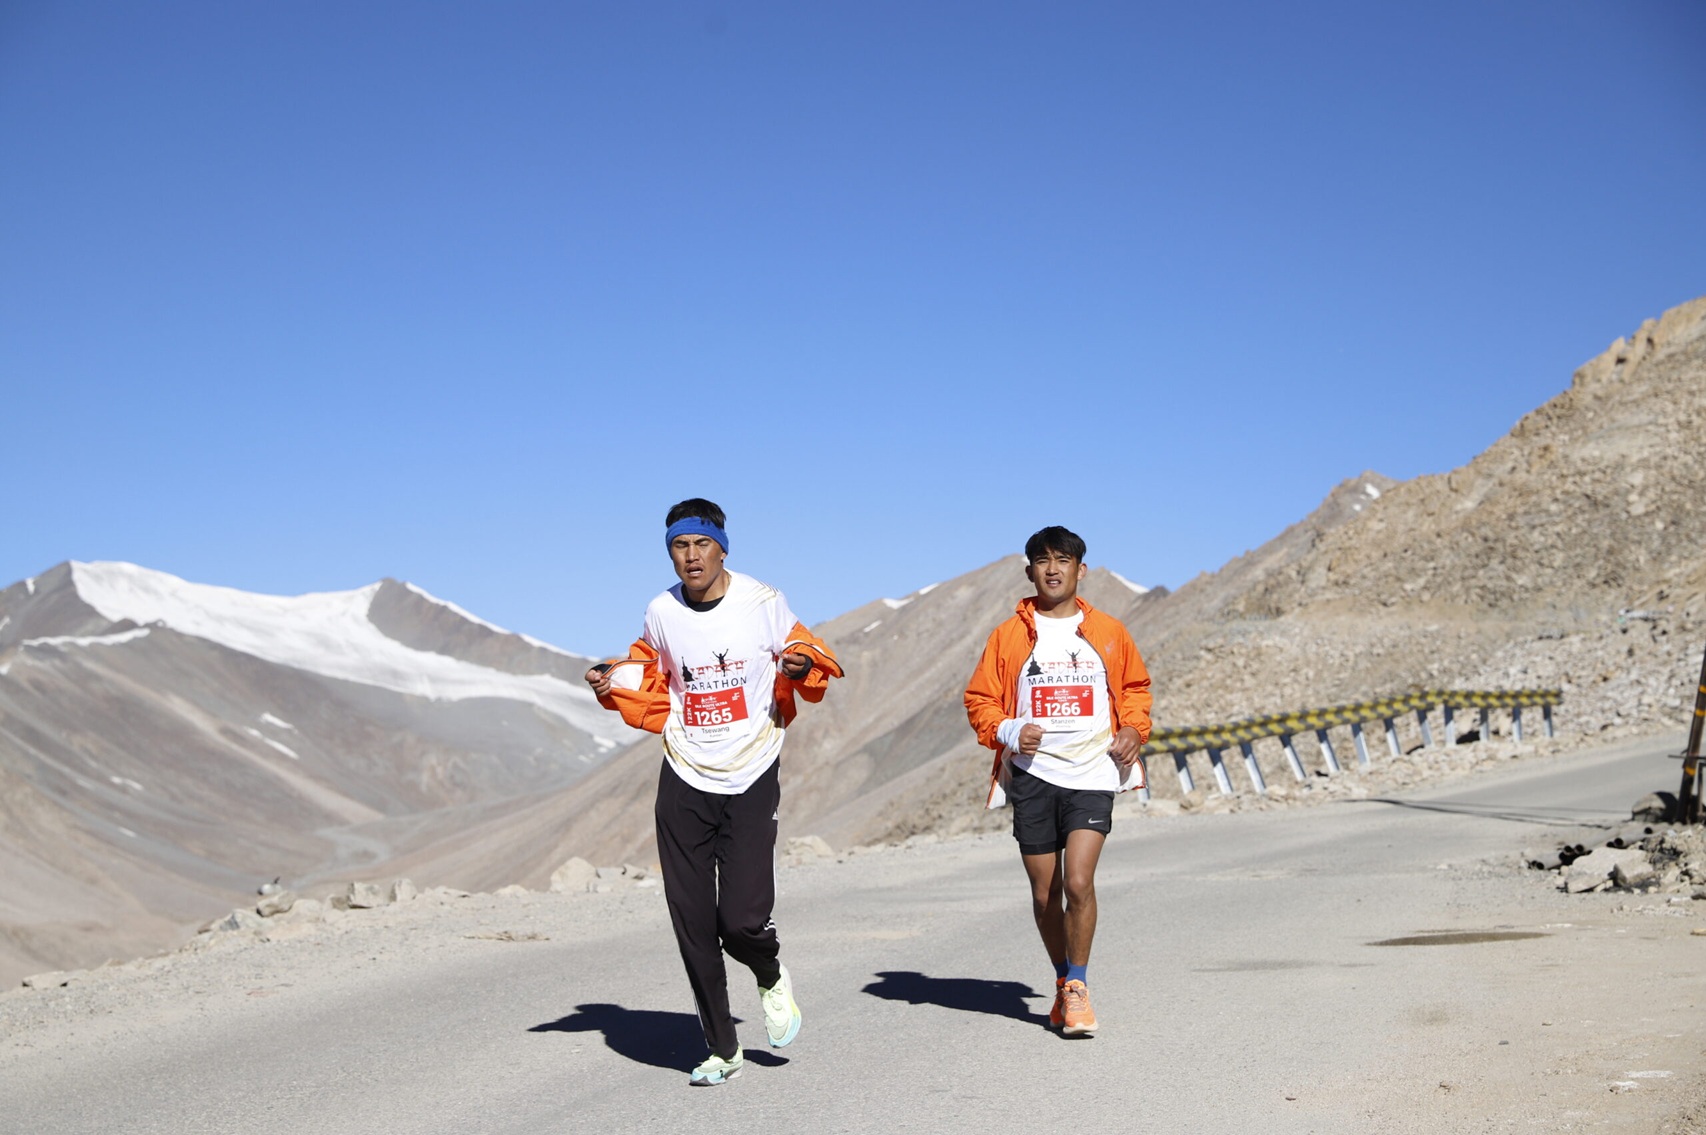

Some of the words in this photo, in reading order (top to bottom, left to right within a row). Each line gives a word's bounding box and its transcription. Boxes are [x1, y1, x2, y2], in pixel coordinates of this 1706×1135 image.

[1028, 675, 1096, 686] MARATHON
[1044, 702, 1081, 716] 1266
[694, 707, 733, 726] 1265
[702, 726, 730, 734] Tsewang
